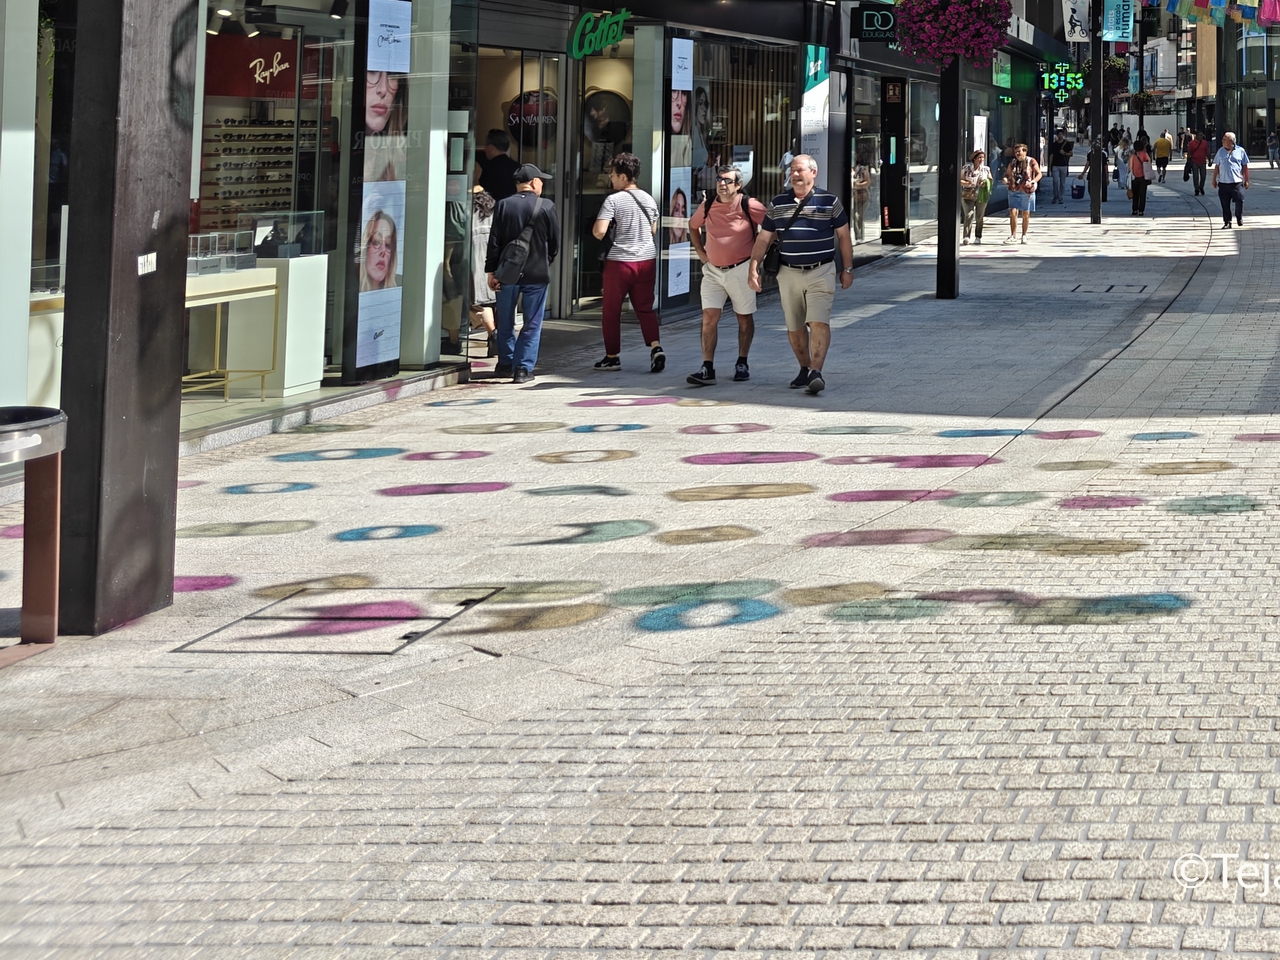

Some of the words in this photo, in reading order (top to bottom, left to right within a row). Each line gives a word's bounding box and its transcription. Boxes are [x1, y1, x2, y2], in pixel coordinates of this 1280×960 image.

[571, 7, 632, 60] Cottet
[862, 30, 894, 38] DOUGLAS
[1041, 73, 1084, 89] 13:53
